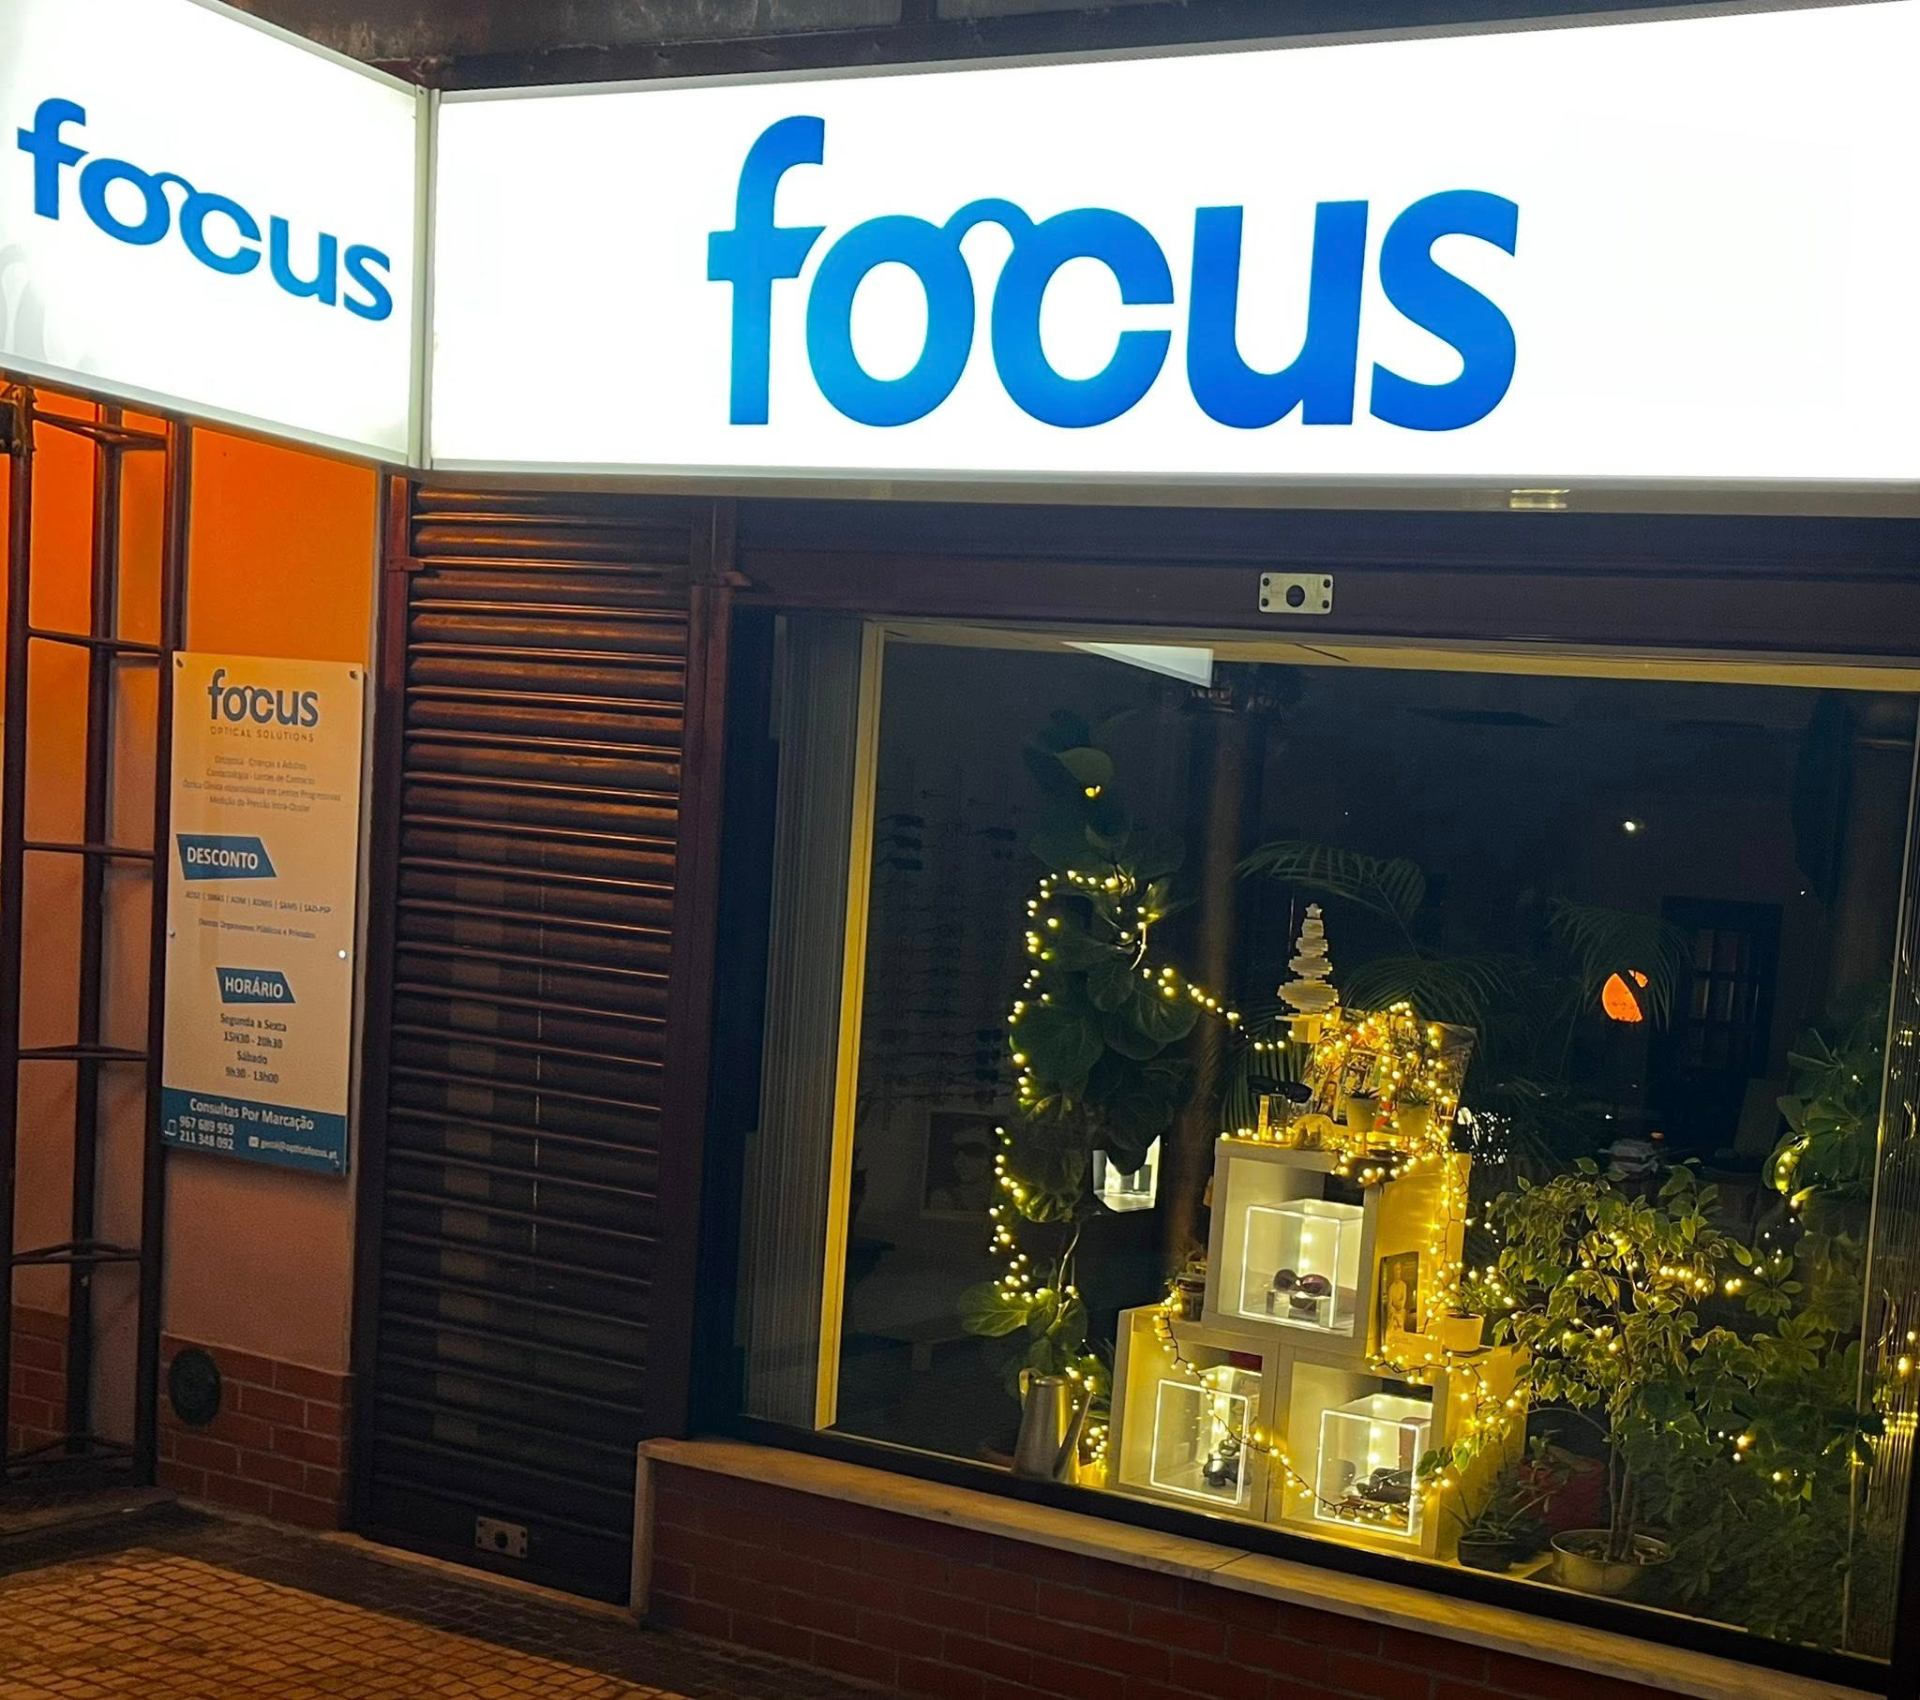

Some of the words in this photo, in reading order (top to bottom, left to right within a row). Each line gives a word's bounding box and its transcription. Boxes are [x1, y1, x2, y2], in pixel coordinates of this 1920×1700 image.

[17, 98, 394, 321] focus
[707, 115, 1519, 432] focus
[207, 668, 319, 728] focus
[209, 726, 252, 738] OPTICAL
[256, 729, 314, 743] SOLUTIONS
[187, 847, 259, 870] DESCONTO
[225, 976, 284, 998] HORÁRIO
[220, 1013, 255, 1027] Segunda
[178, 1115, 196, 1129] 967
[190, 1097, 240, 1119] Consultas
[241, 1106, 260, 1122] Por
[261, 1109, 314, 1132] Marcação
[179, 1129, 196, 1144] 211
